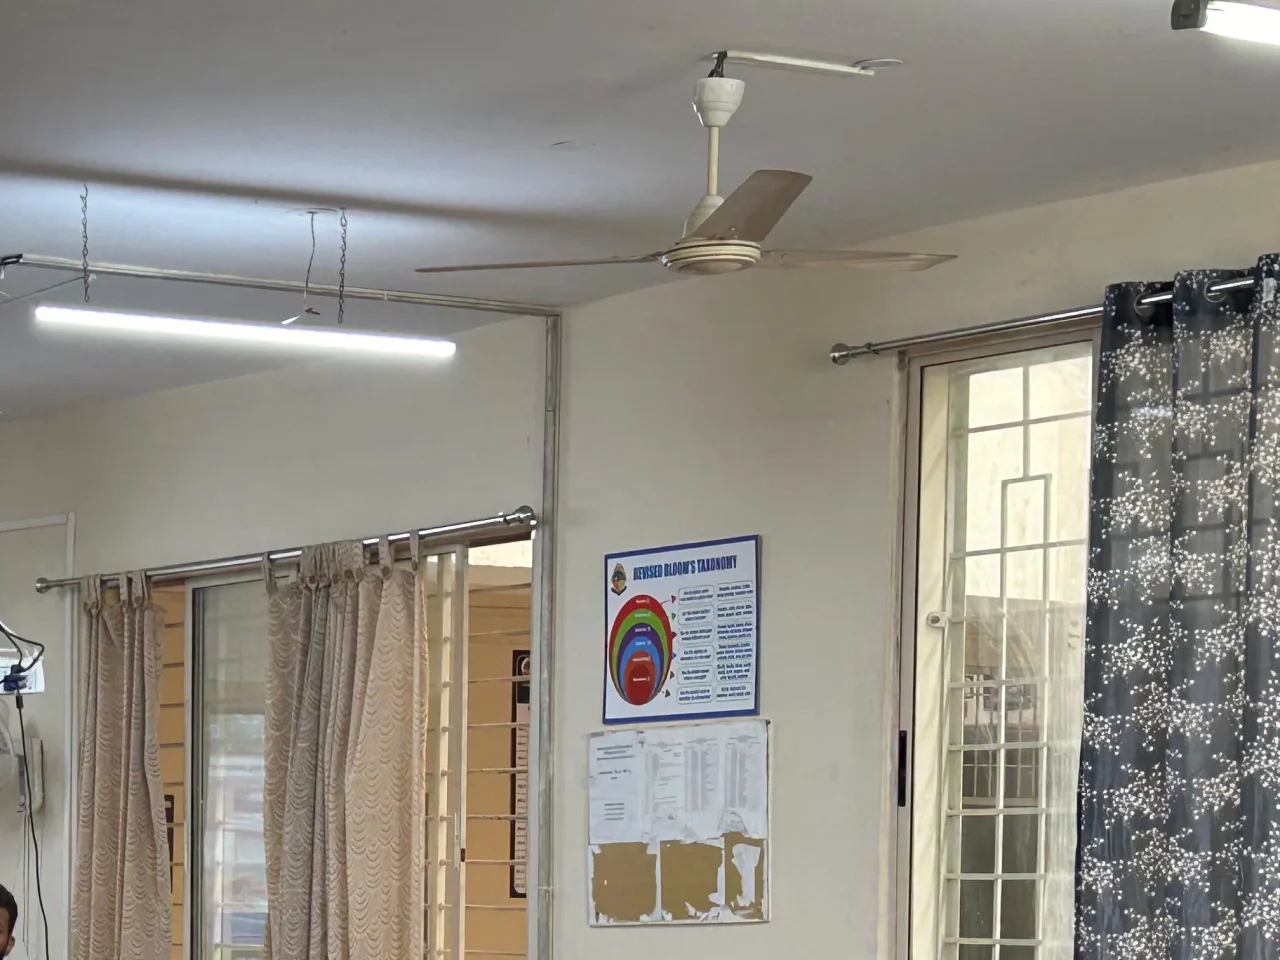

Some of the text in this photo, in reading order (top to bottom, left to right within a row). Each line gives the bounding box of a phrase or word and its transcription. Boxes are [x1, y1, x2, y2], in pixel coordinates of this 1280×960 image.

[633, 555, 738, 581] REVISED BLOOM'S TAXONOMY
